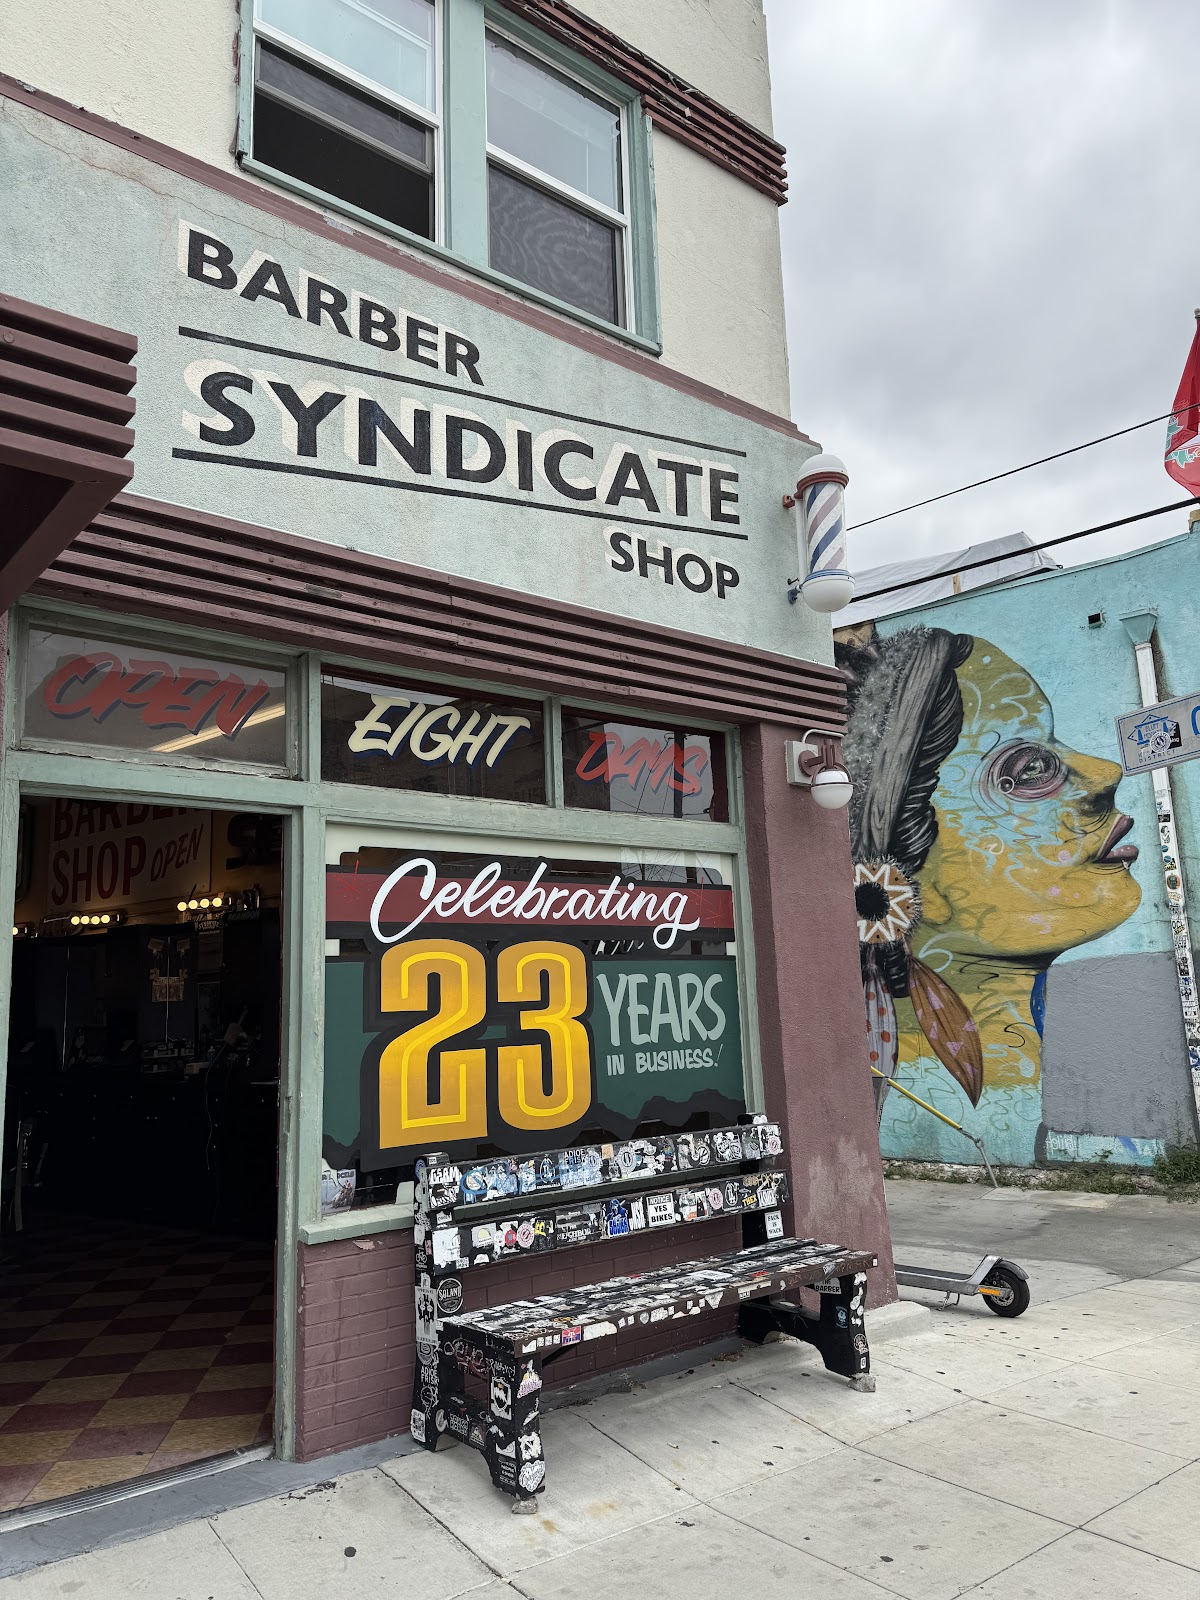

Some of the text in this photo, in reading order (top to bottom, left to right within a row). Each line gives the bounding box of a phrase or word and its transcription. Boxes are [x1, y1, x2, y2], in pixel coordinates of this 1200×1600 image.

[186, 227, 484, 387] BARBER
[199, 370, 741, 527] SYNDICATE
[609, 530, 740, 600] SHOP
[43, 651, 271, 740] OPEN
[347, 694, 533, 770] EIGHT
[1138, 749, 1176, 764] DISTRICT
[51, 835, 147, 906] SHOP
[151, 822, 205, 882] OPEN
[369, 857, 700, 950] Celebrating
[378, 938, 592, 1149] 23
[595, 972, 727, 1047] YEARS
[606, 1043, 724, 1076] IN BUSINESS!
[649, 1195, 670, 1205] NOTICE
[650, 1213, 673, 1224] BIKES
[653, 1205, 669, 1214] YES
[815, 1284, 840, 1293] BARBER
